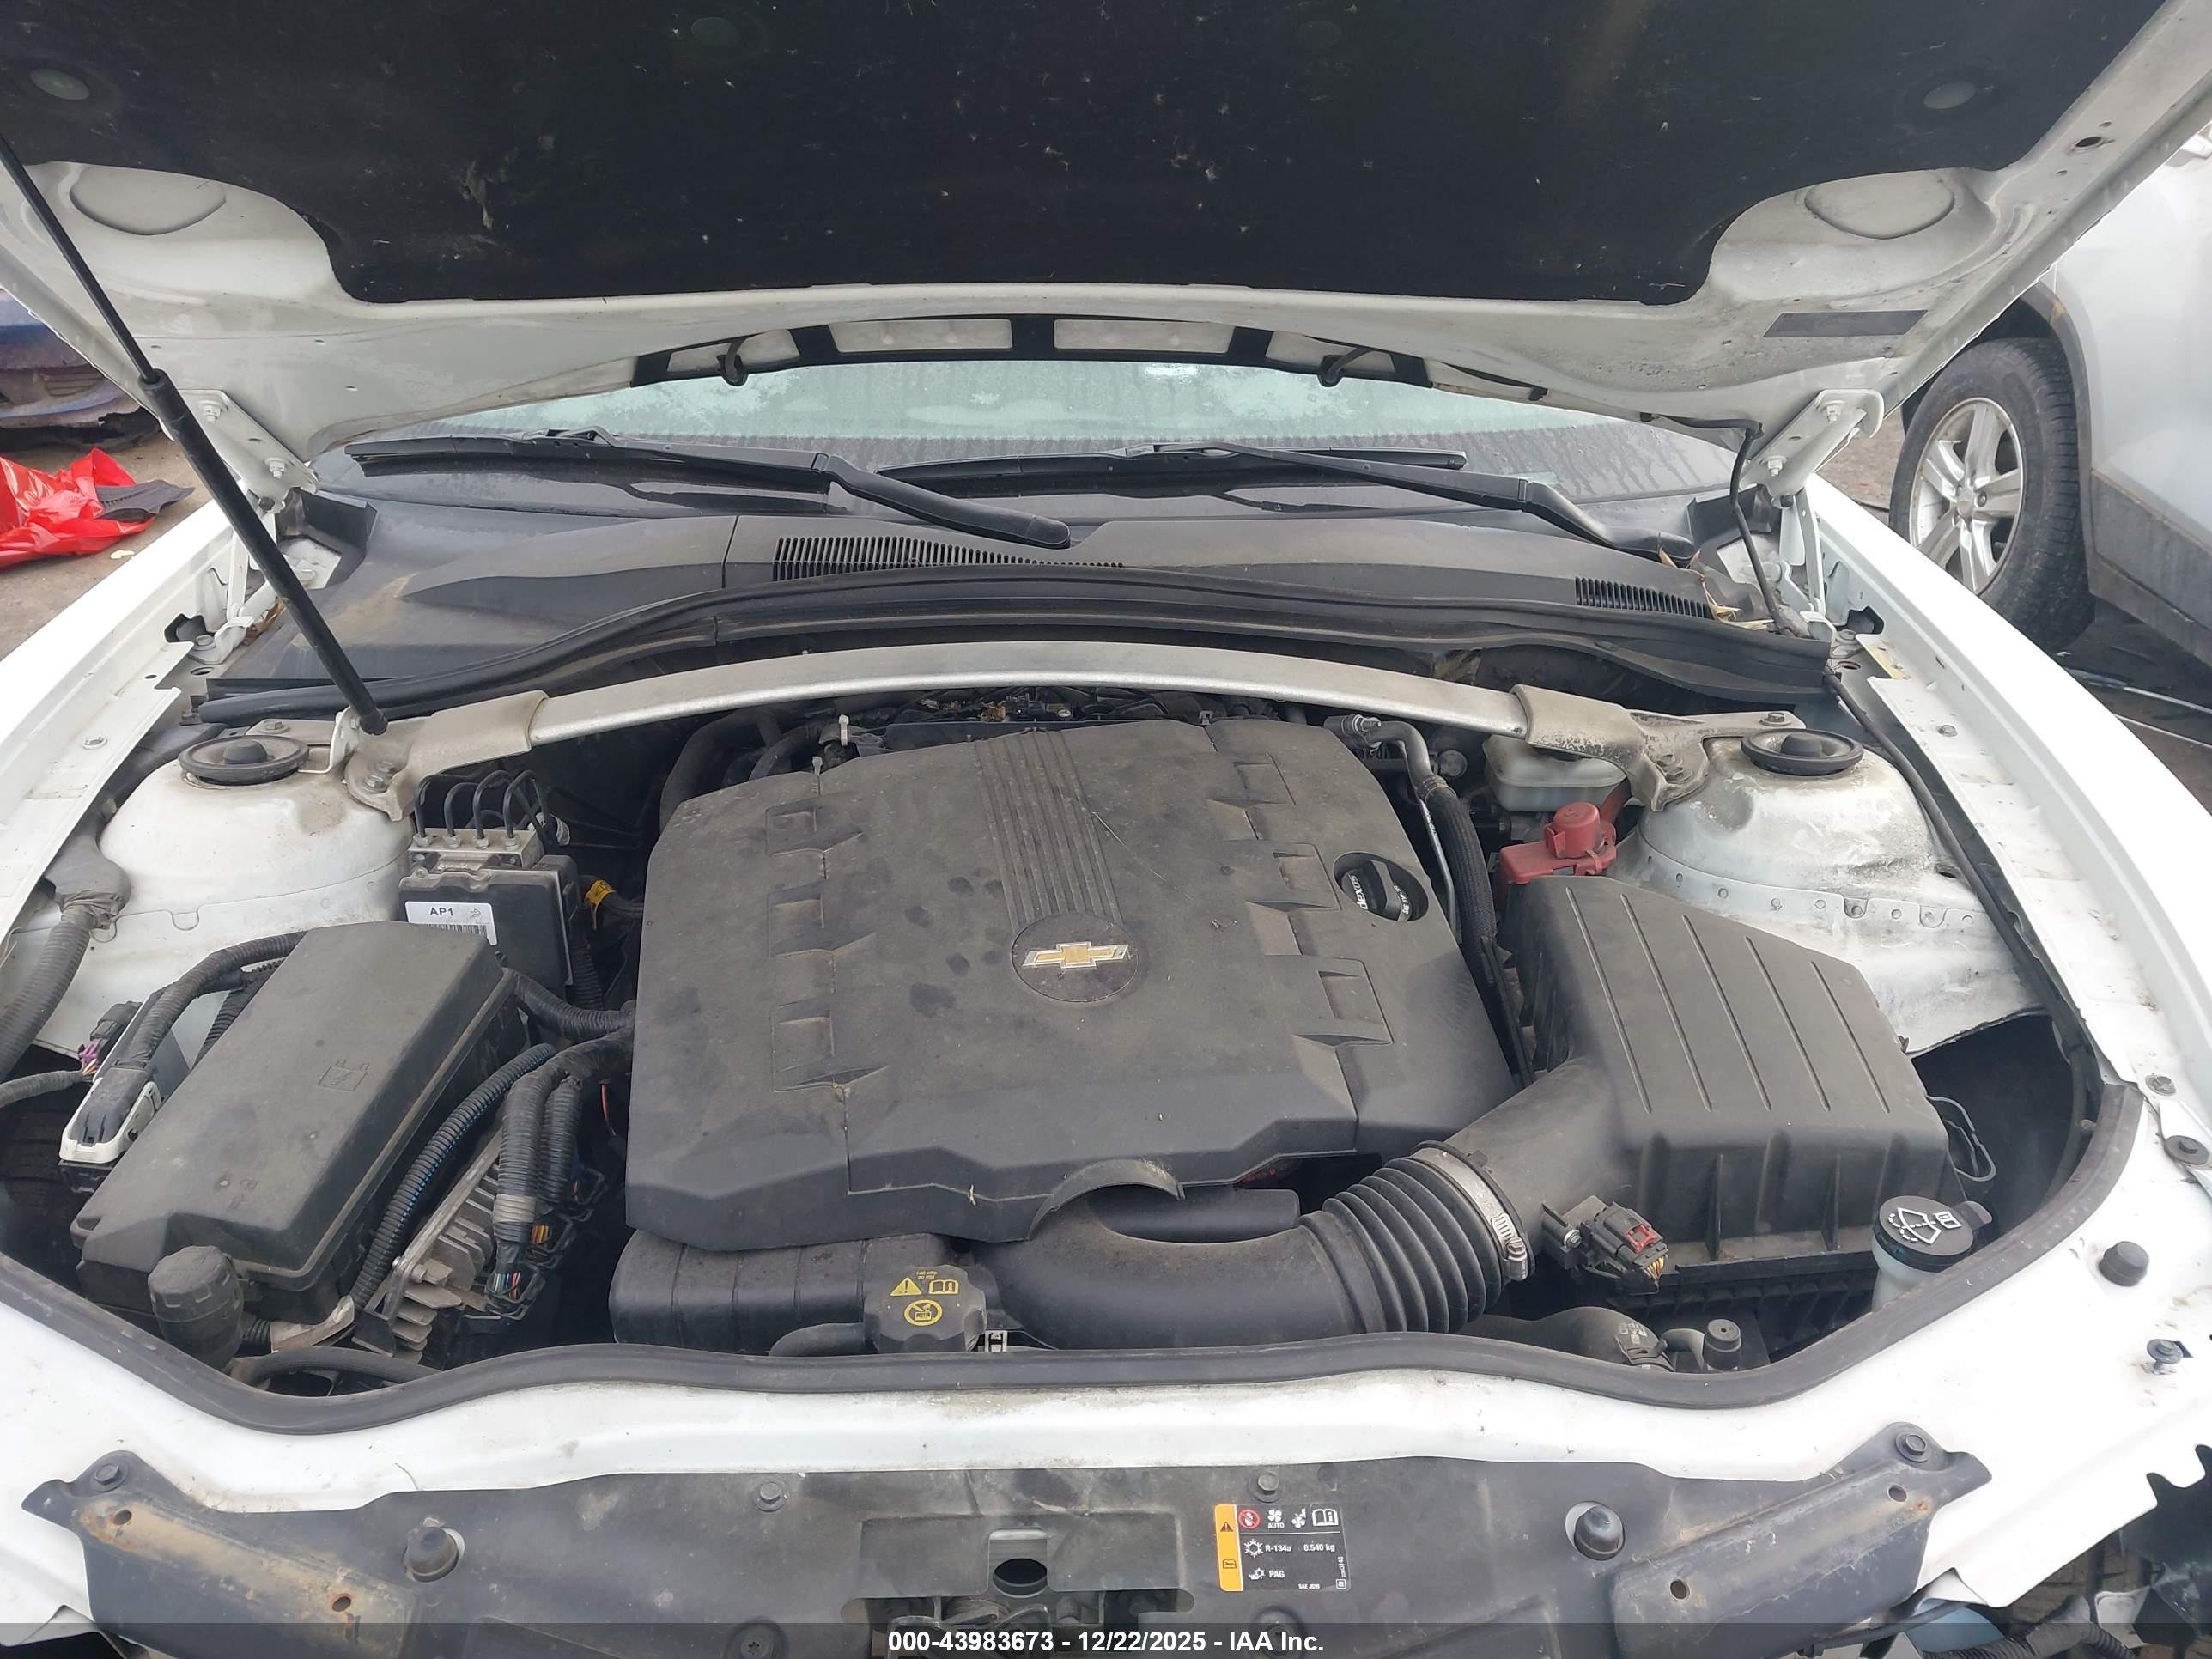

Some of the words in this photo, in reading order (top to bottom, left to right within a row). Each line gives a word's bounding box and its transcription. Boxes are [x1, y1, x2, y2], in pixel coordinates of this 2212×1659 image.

[1348, 874, 1368, 910] dexos
[429, 907, 453, 916] AP1
[1325, 1543, 1335, 1552] kg
[1268, 1570, 1285, 1578] PAG
